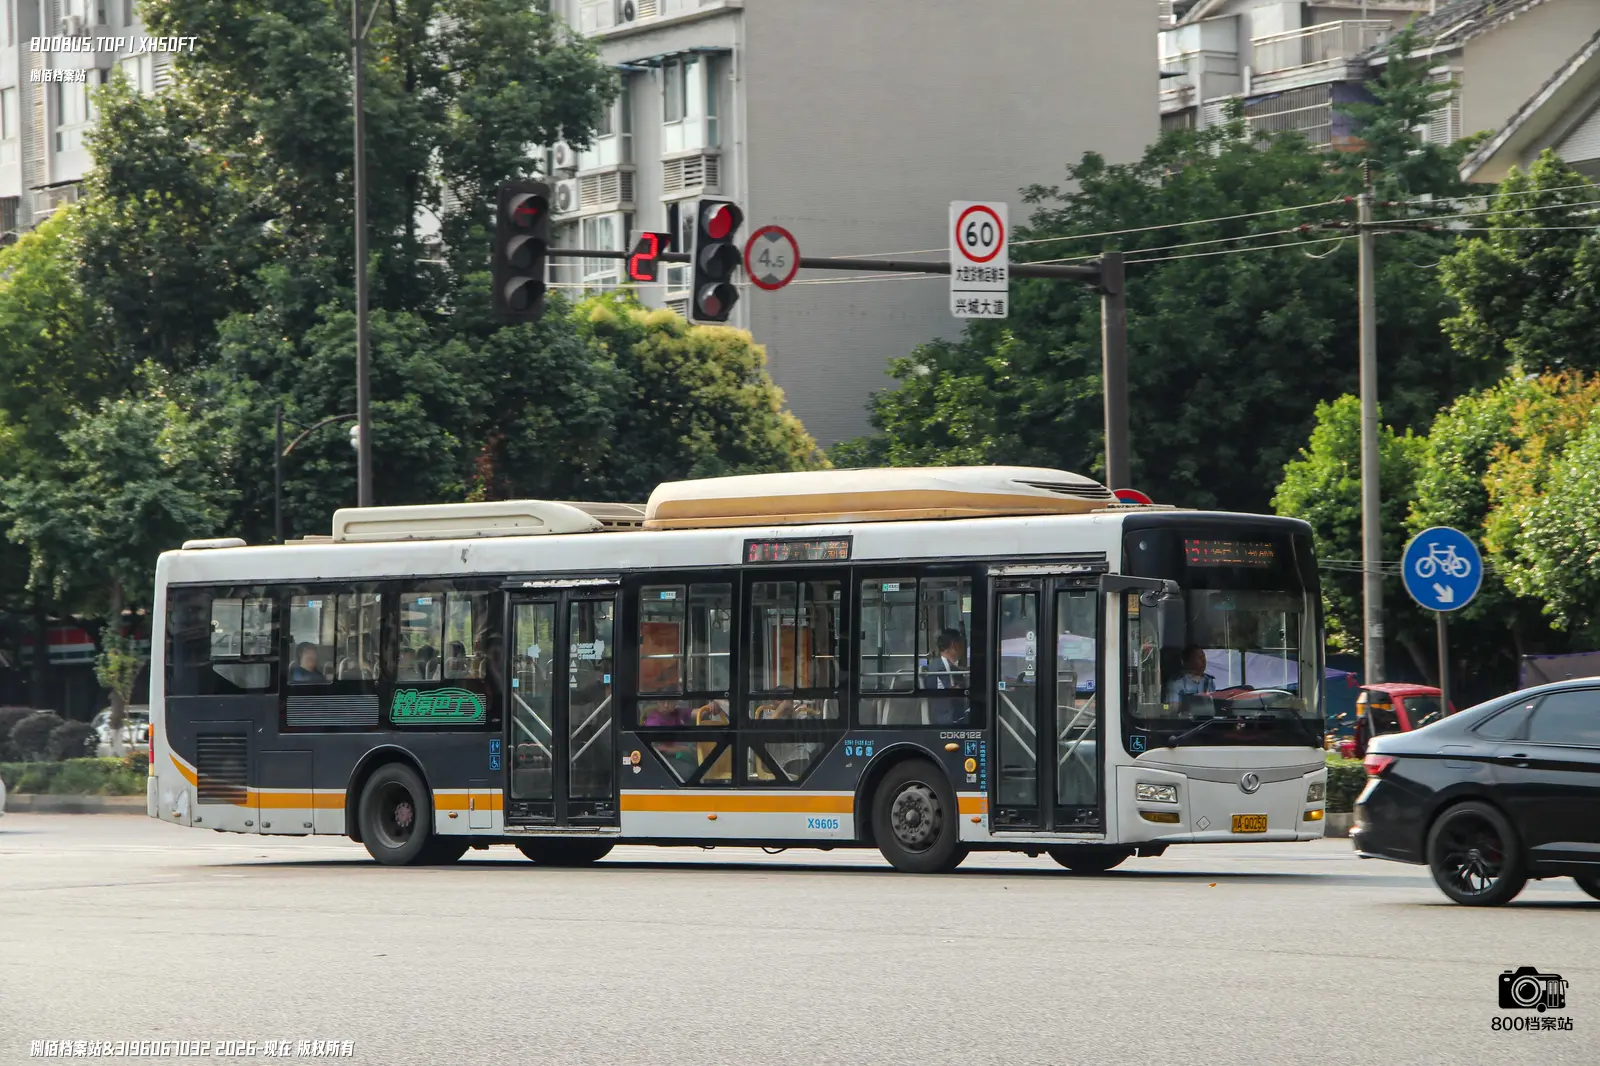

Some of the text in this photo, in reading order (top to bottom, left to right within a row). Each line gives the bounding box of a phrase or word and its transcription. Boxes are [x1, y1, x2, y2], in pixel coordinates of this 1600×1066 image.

[966, 221, 994, 247] 60
[629, 232, 659, 281] 2
[758, 248, 786, 268] 4.5
[956, 299, 1005, 315] 兴城大道
[940, 731, 982, 739] CDK6122
[807, 817, 839, 830] X9605
